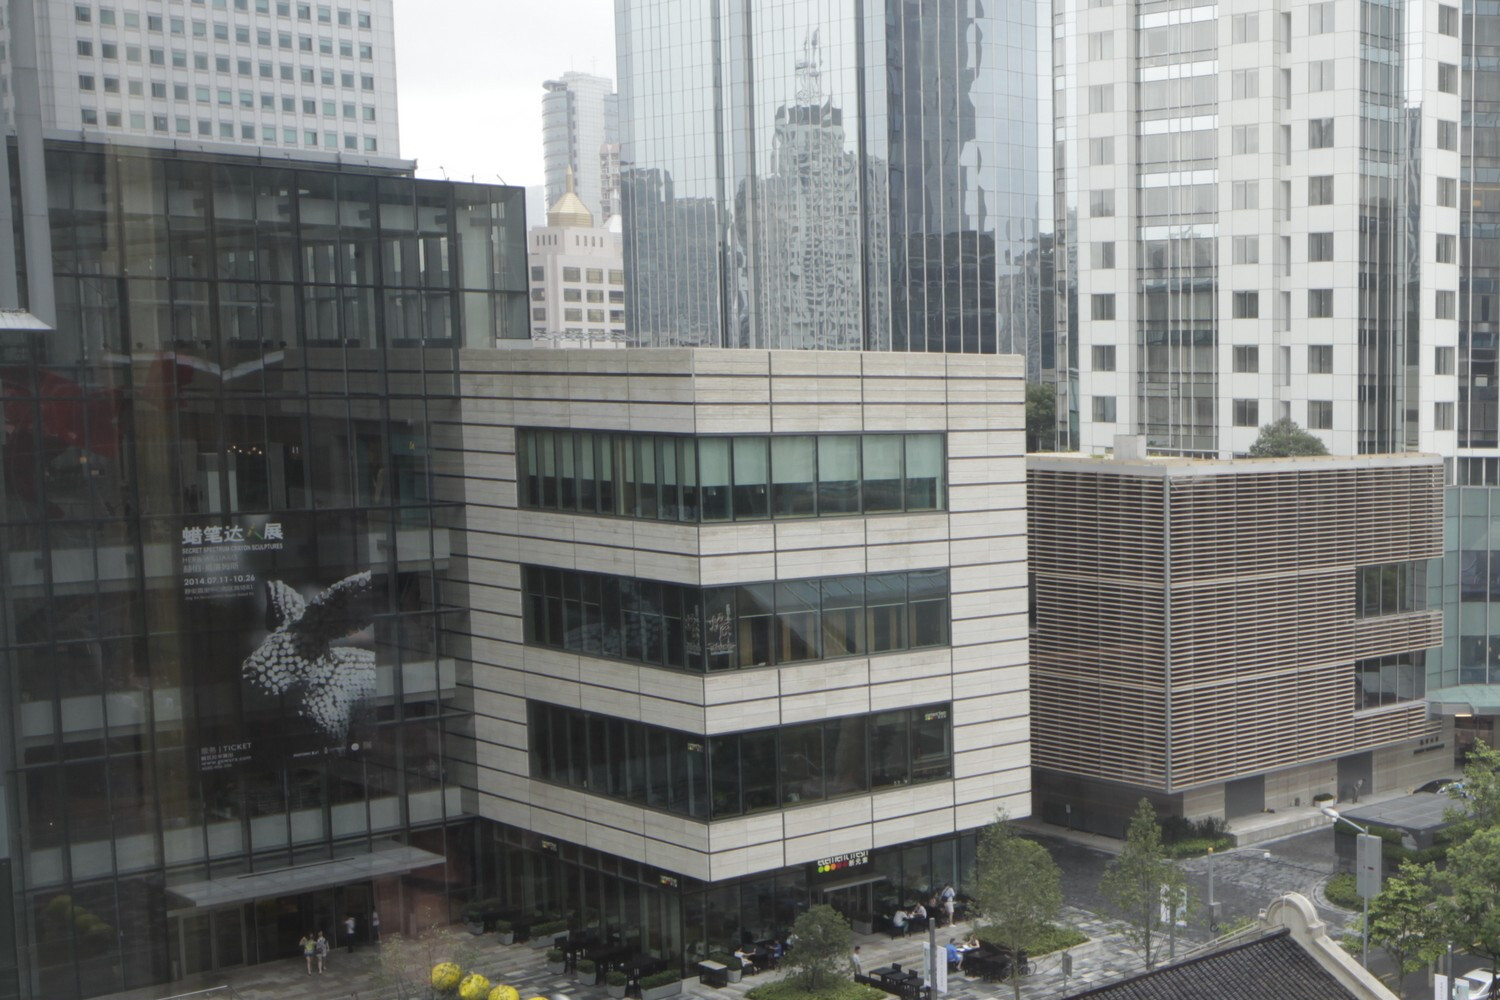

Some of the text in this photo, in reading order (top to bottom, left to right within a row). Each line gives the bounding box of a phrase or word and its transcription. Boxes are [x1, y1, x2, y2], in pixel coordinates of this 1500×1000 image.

[182, 523, 283, 544] 蜡笔达人展
[182, 547, 202, 555] SECRET
[230, 544, 251, 552] CRAYON
[251, 543, 283, 551] SCULPTURES
[184, 574, 256, 586] 2014.07.11-10.26
[223, 742, 252, 751] TICKET
